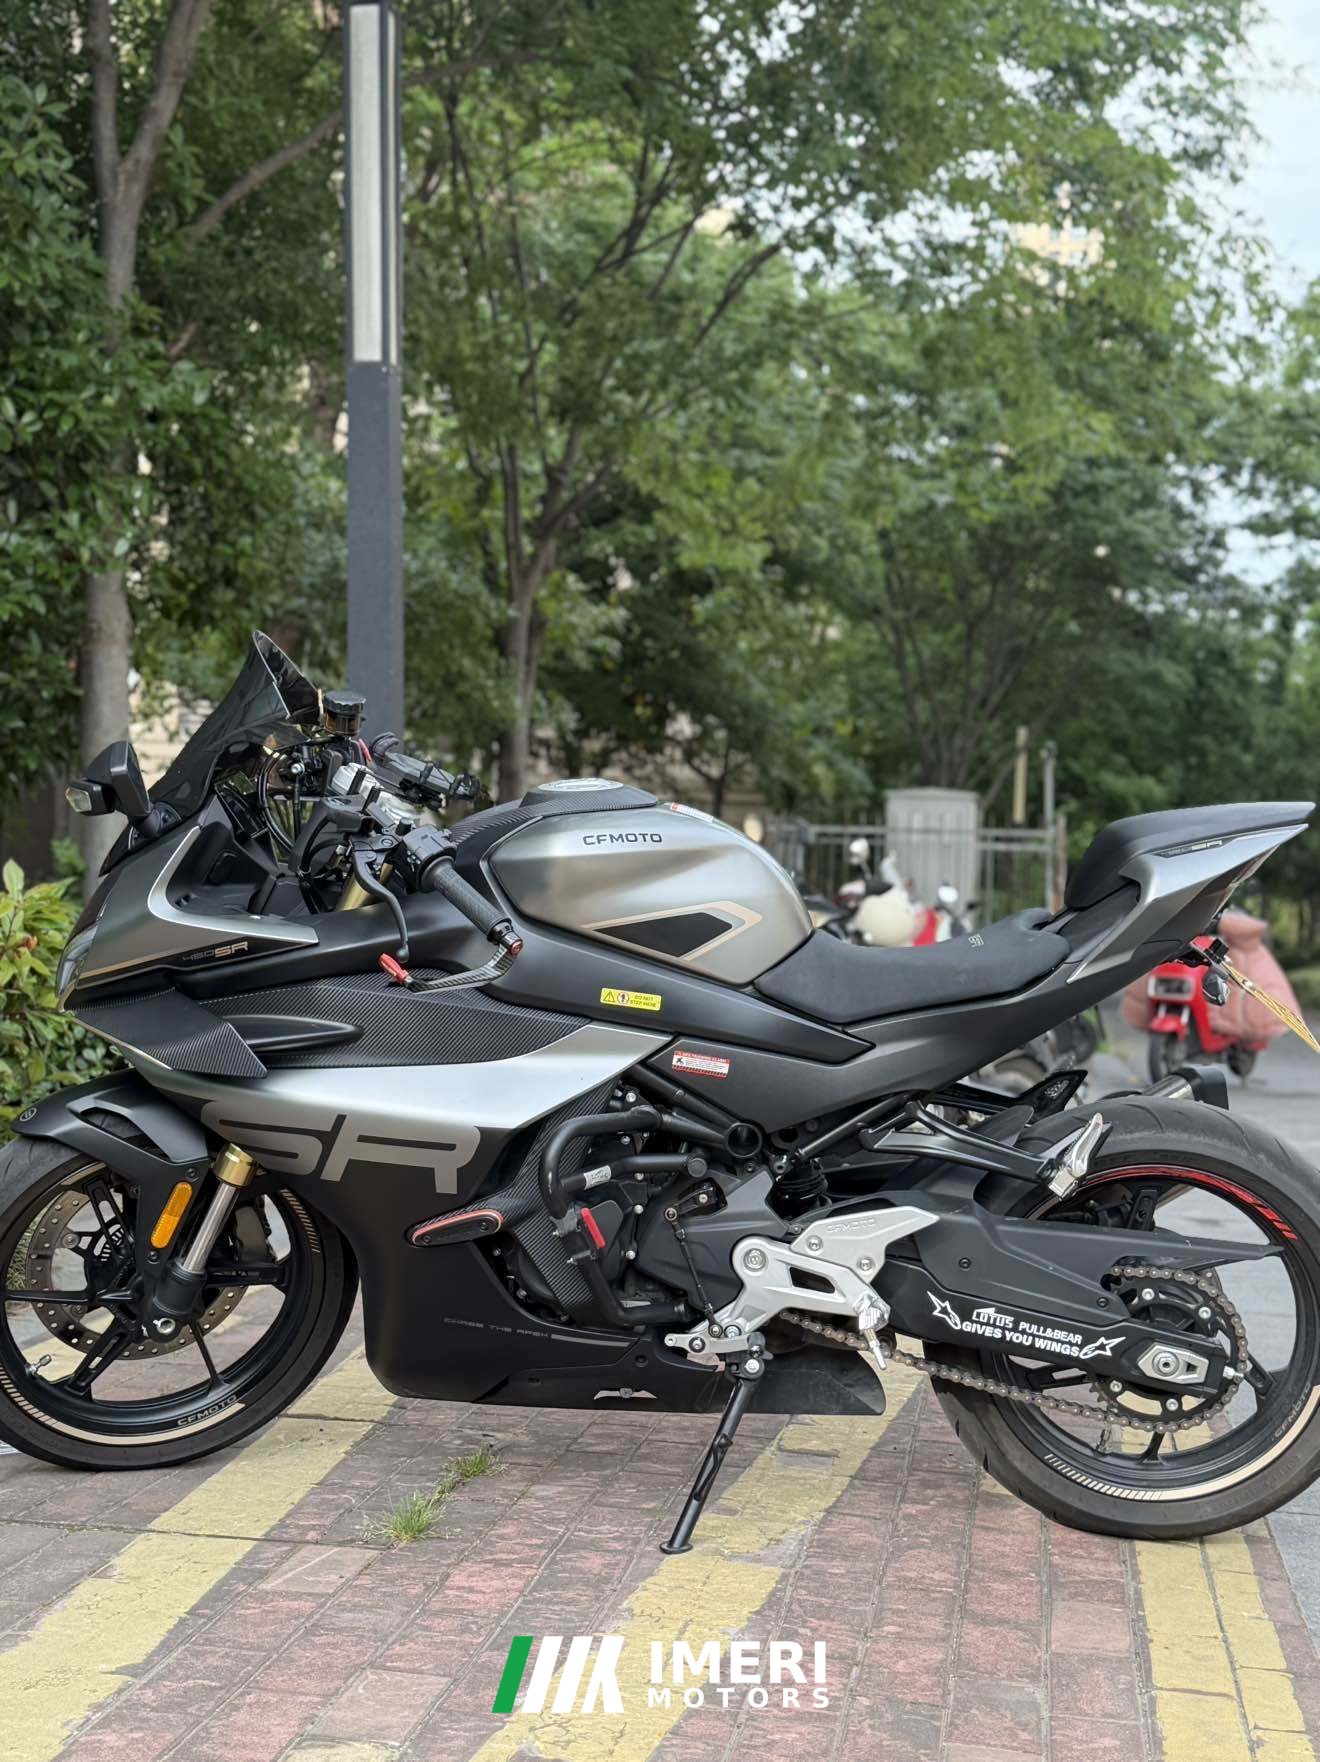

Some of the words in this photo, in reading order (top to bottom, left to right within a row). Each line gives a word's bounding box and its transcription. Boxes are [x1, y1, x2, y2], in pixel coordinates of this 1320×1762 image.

[582, 832, 663, 846] CFMOTO
[201, 1098, 480, 1194] SR
[962, 1320, 1003, 1339] GIVES
[1004, 1330, 1034, 1346] YOU
[1034, 1337, 1081, 1358] WINGS
[972, 1307, 1015, 1329] LOTUS
[1018, 1321, 1083, 1345] PULL&BEAR
[177, 1394, 238, 1426] CFMOTO
